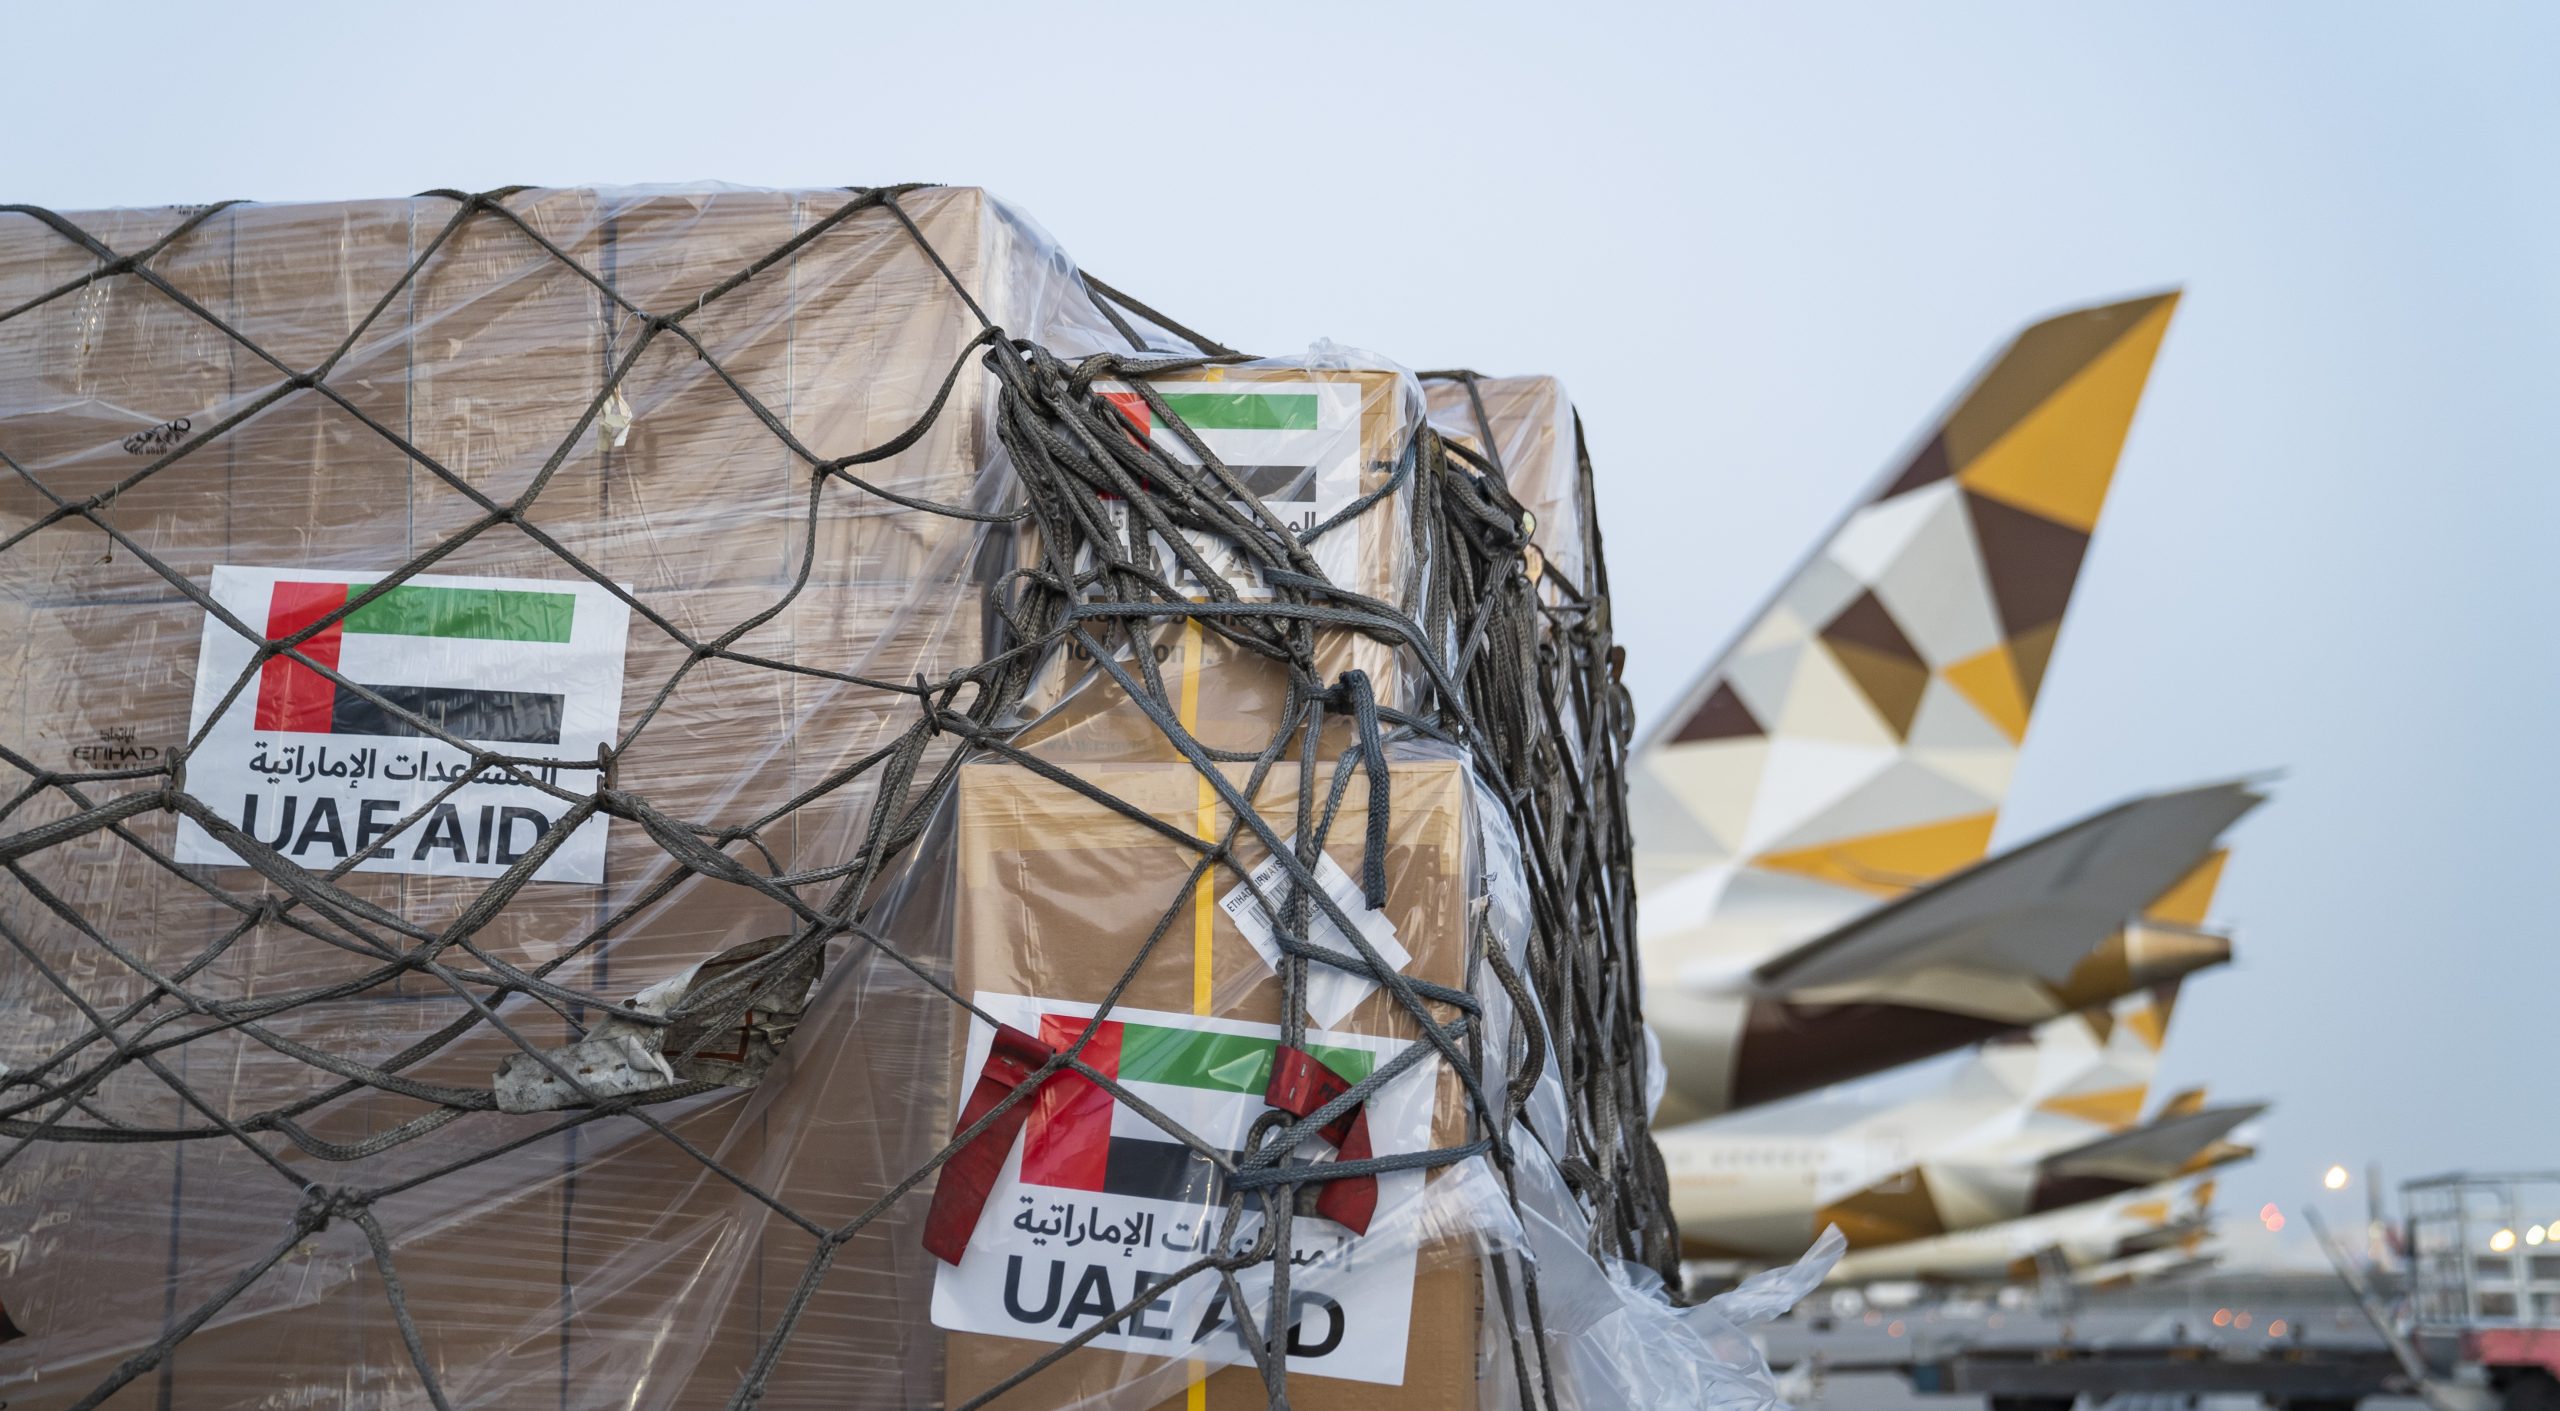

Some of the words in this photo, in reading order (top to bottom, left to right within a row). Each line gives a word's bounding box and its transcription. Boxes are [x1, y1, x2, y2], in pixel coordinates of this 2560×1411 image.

[73, 747, 159, 761] ETIHAD
[249, 741, 376, 788] الإماراتية
[242, 794, 400, 859] UAE
[411, 803, 551, 865] AID
[1253, 859, 1284, 887] IRWAYS
[1013, 1195, 1154, 1257] الإماراتية
[1003, 1254, 1174, 1341] UAE
